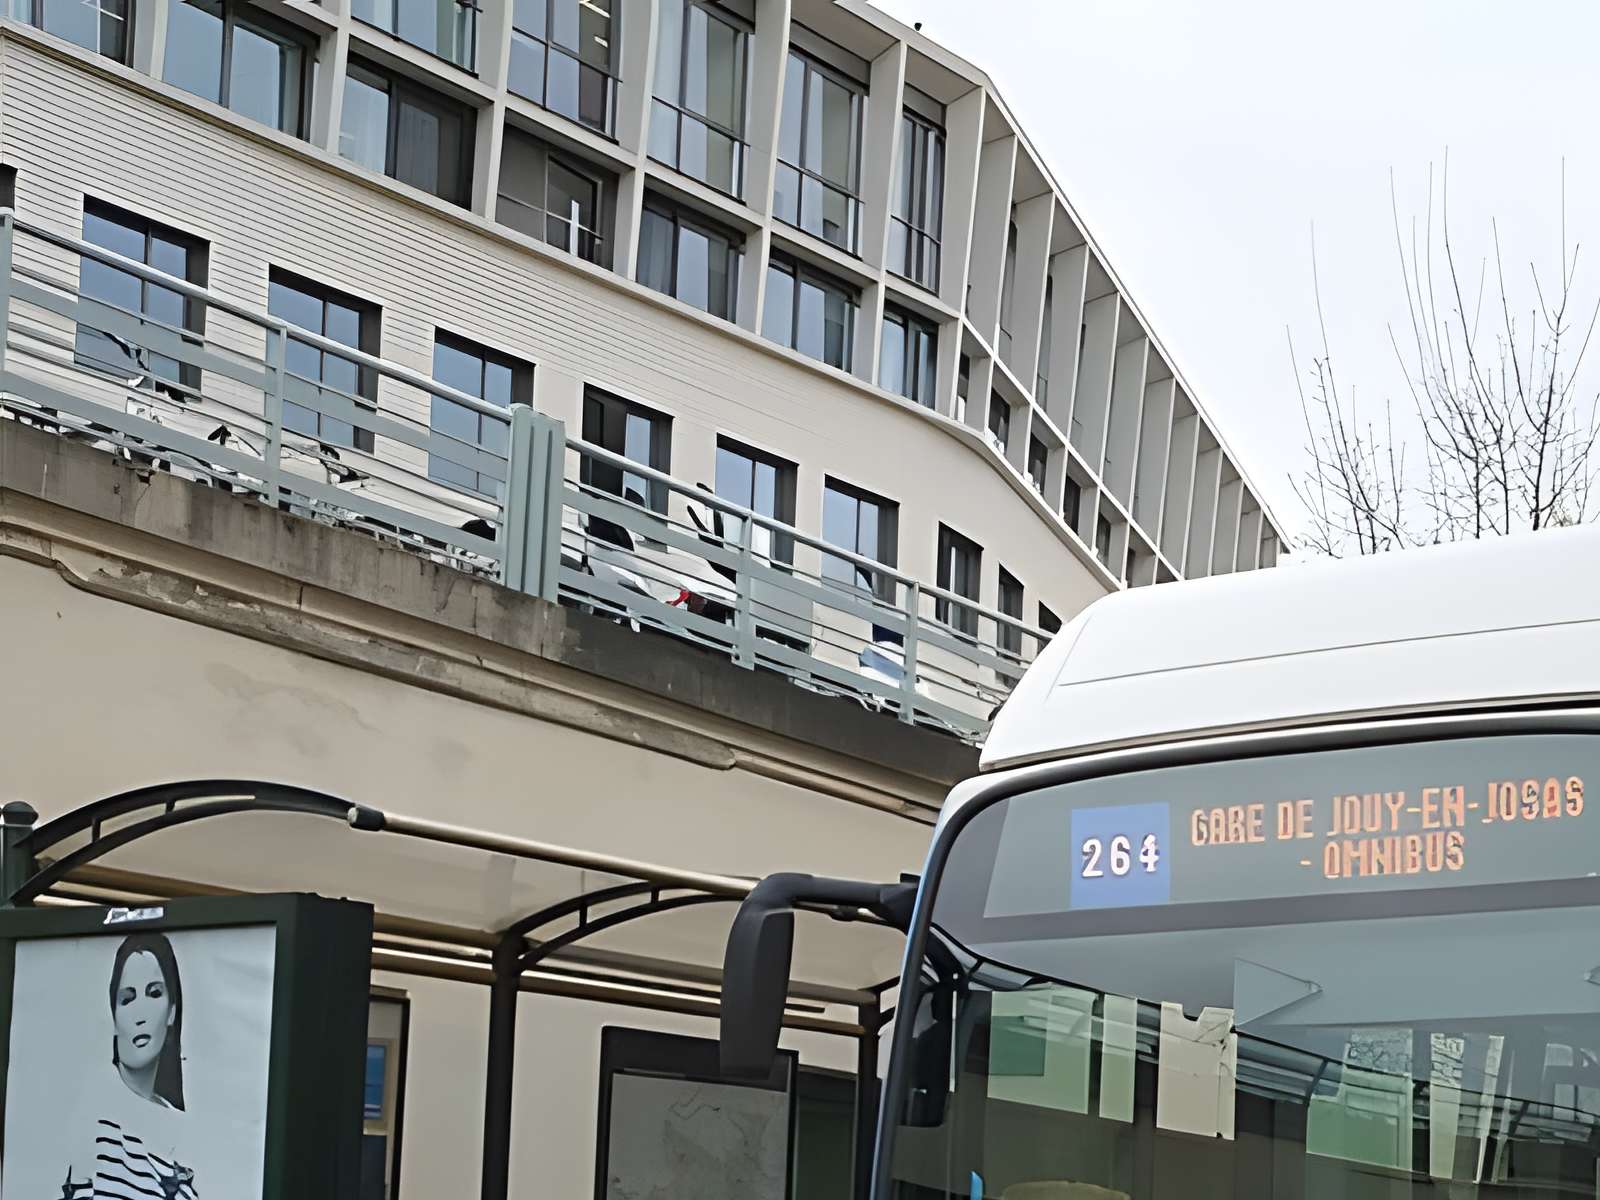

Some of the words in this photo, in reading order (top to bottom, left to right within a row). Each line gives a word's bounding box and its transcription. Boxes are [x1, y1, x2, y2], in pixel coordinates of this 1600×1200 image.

[1191, 803, 1265, 846] GARE
[1277, 799, 1315, 840] DE
[1326, 776, 1585, 837] JOUY-EN-JOSAS
[1081, 833, 1160, 878] 264
[1322, 830, 1466, 879] OMNIBUS
